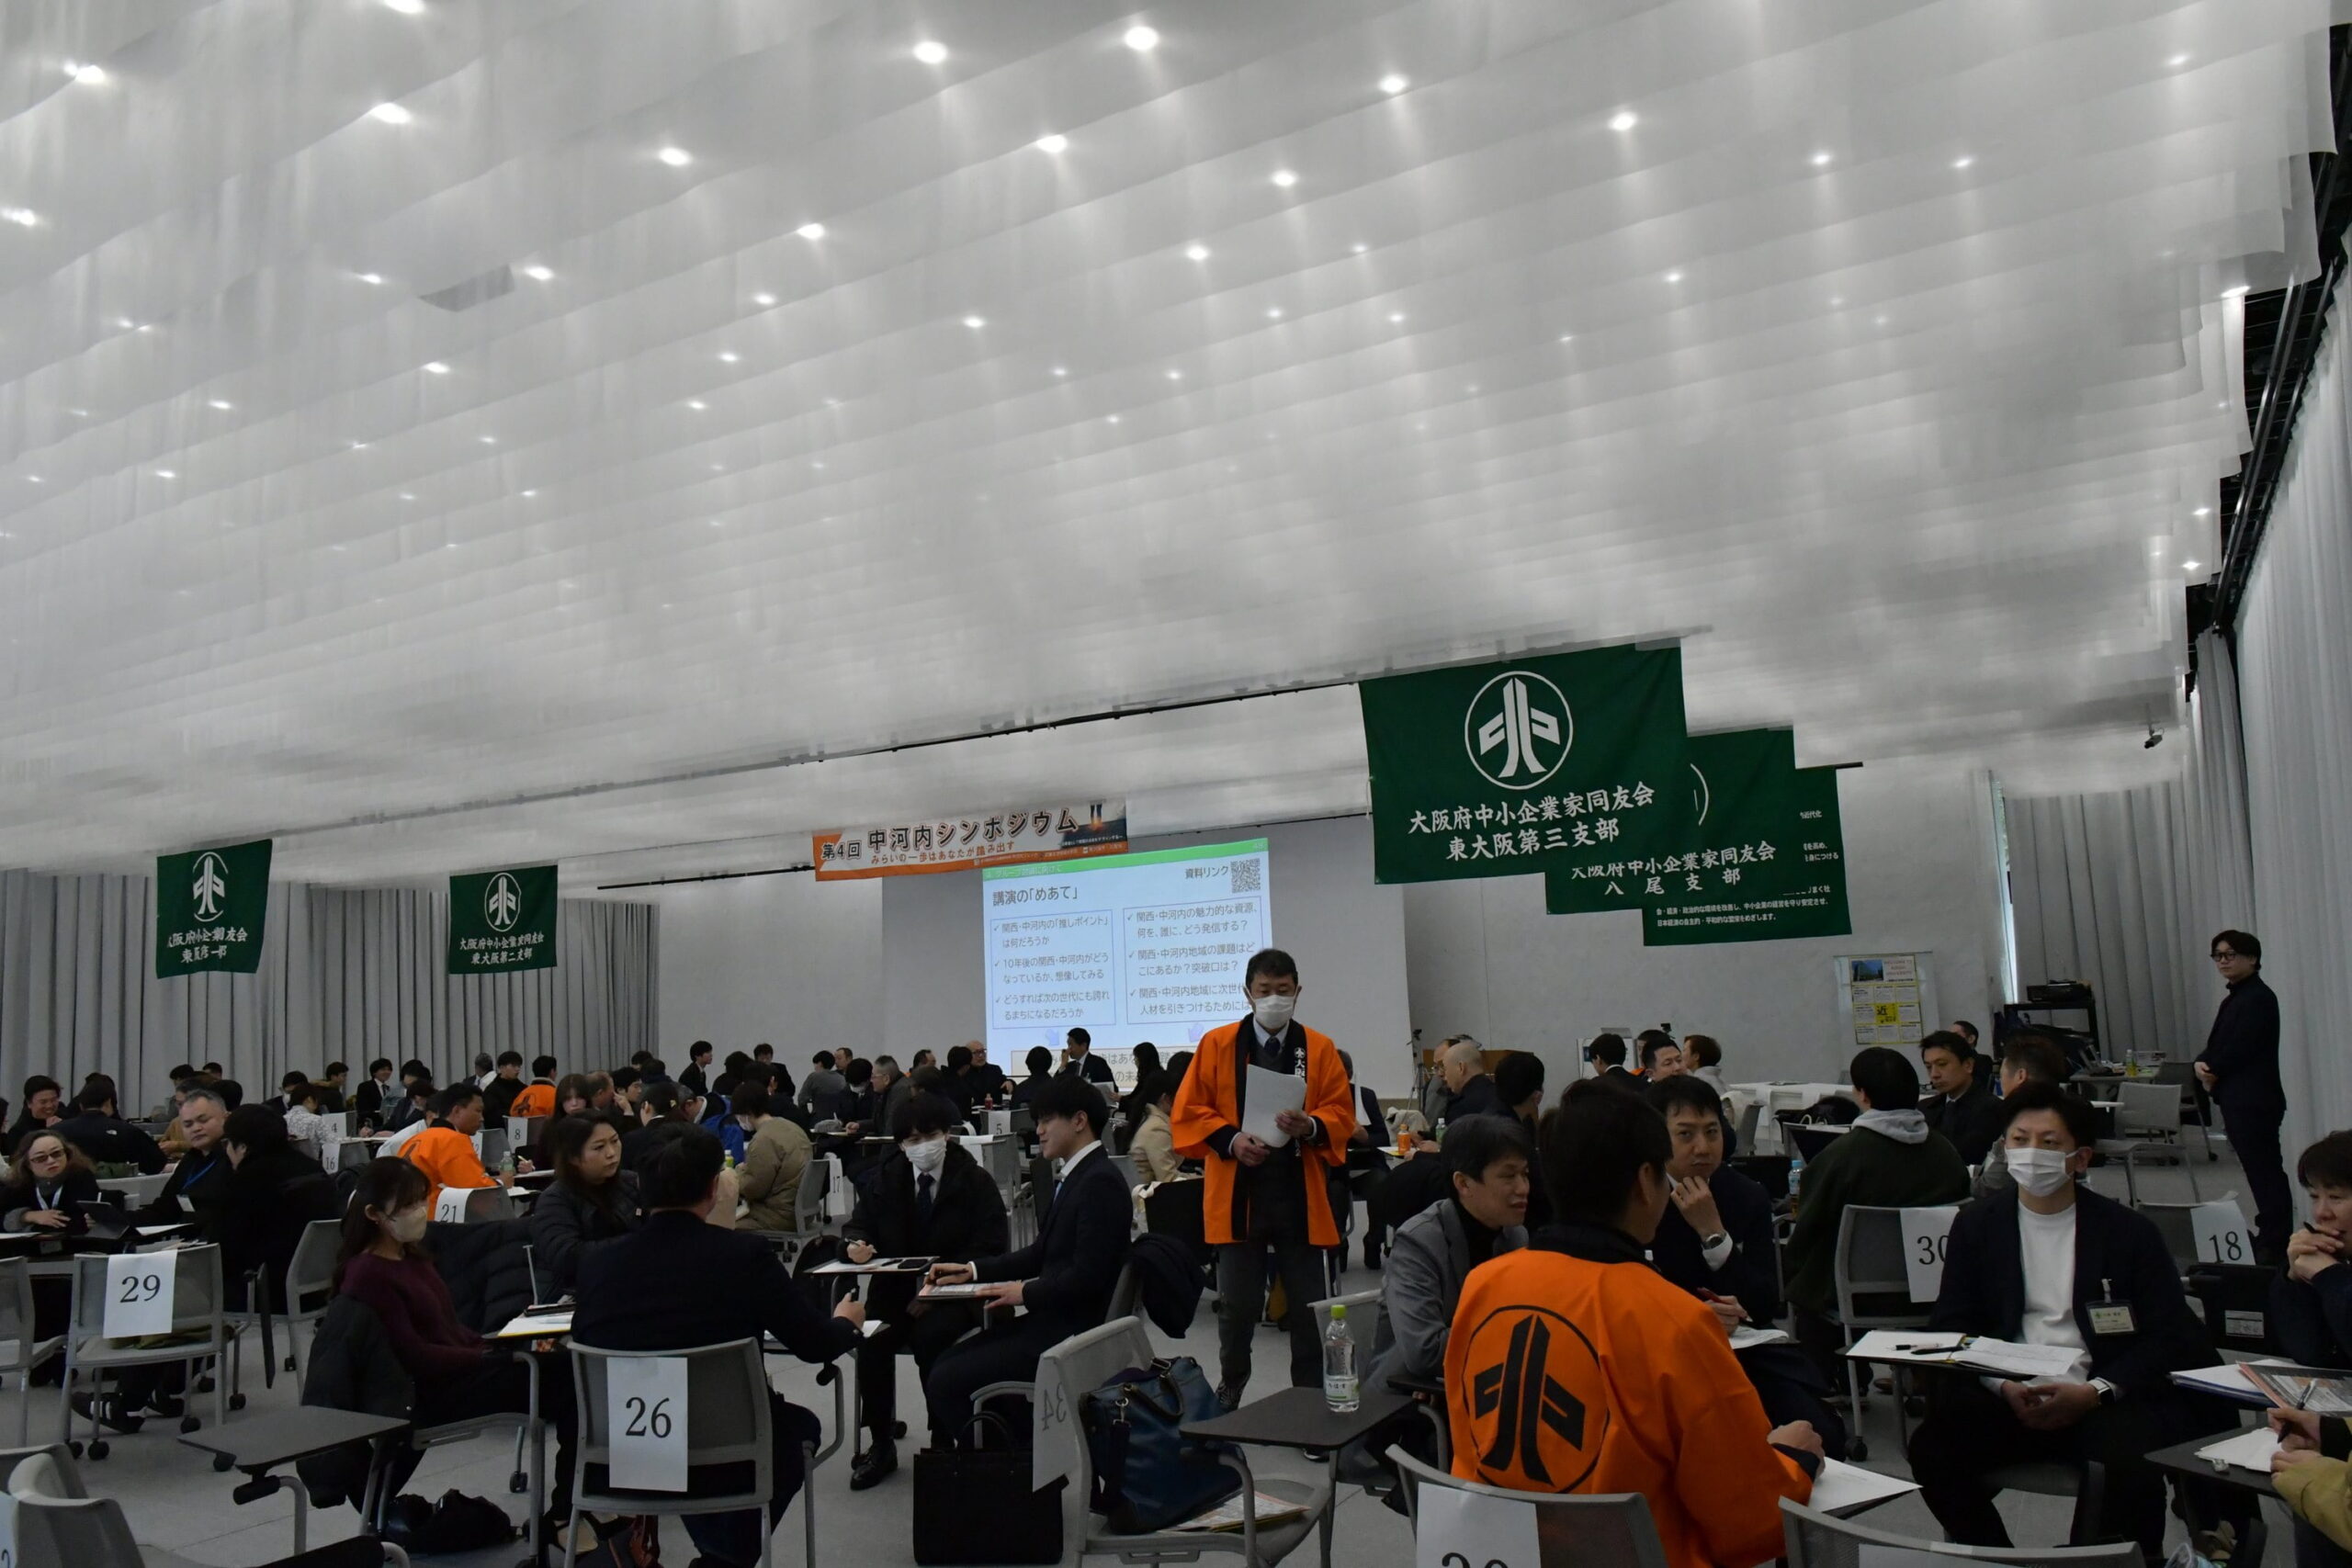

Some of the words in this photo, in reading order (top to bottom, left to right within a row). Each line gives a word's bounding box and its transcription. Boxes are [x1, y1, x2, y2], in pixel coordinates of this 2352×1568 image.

[1408, 781, 1655, 834] 大阪府中小企業家同友会
[822, 841, 862, 860] 第4回
[868, 808, 1079, 852] 中河内シンポジウム
[1446, 817, 1620, 862] 東大阪第三支部
[871, 840, 1015, 864] みらいの一歩はあなたが踏み出す
[1185, 866, 1229, 879] 資料リンク
[992, 886, 1078, 907] 講演の「めあて」
[1002, 937, 1050, 948] は何だろうか
[1137, 942, 1256, 961] 関西・中河内地域の課題はど
[1003, 953, 1109, 968] 10年後の関西・中河内がどう
[1138, 961, 1238, 976] こにあるか？突破口は？
[1003, 969, 1104, 985] なっているか、想像してみる
[1005, 1009, 1084, 1021] るまちになるだろうか
[514, 1129, 521, 1141] 8
[325, 1156, 336, 1171] 16
[442, 1204, 458, 1223] 21
[2209, 1231, 2243, 1264] 18
[120, 1274, 161, 1303] 29
[626, 1396, 672, 1438] 26
